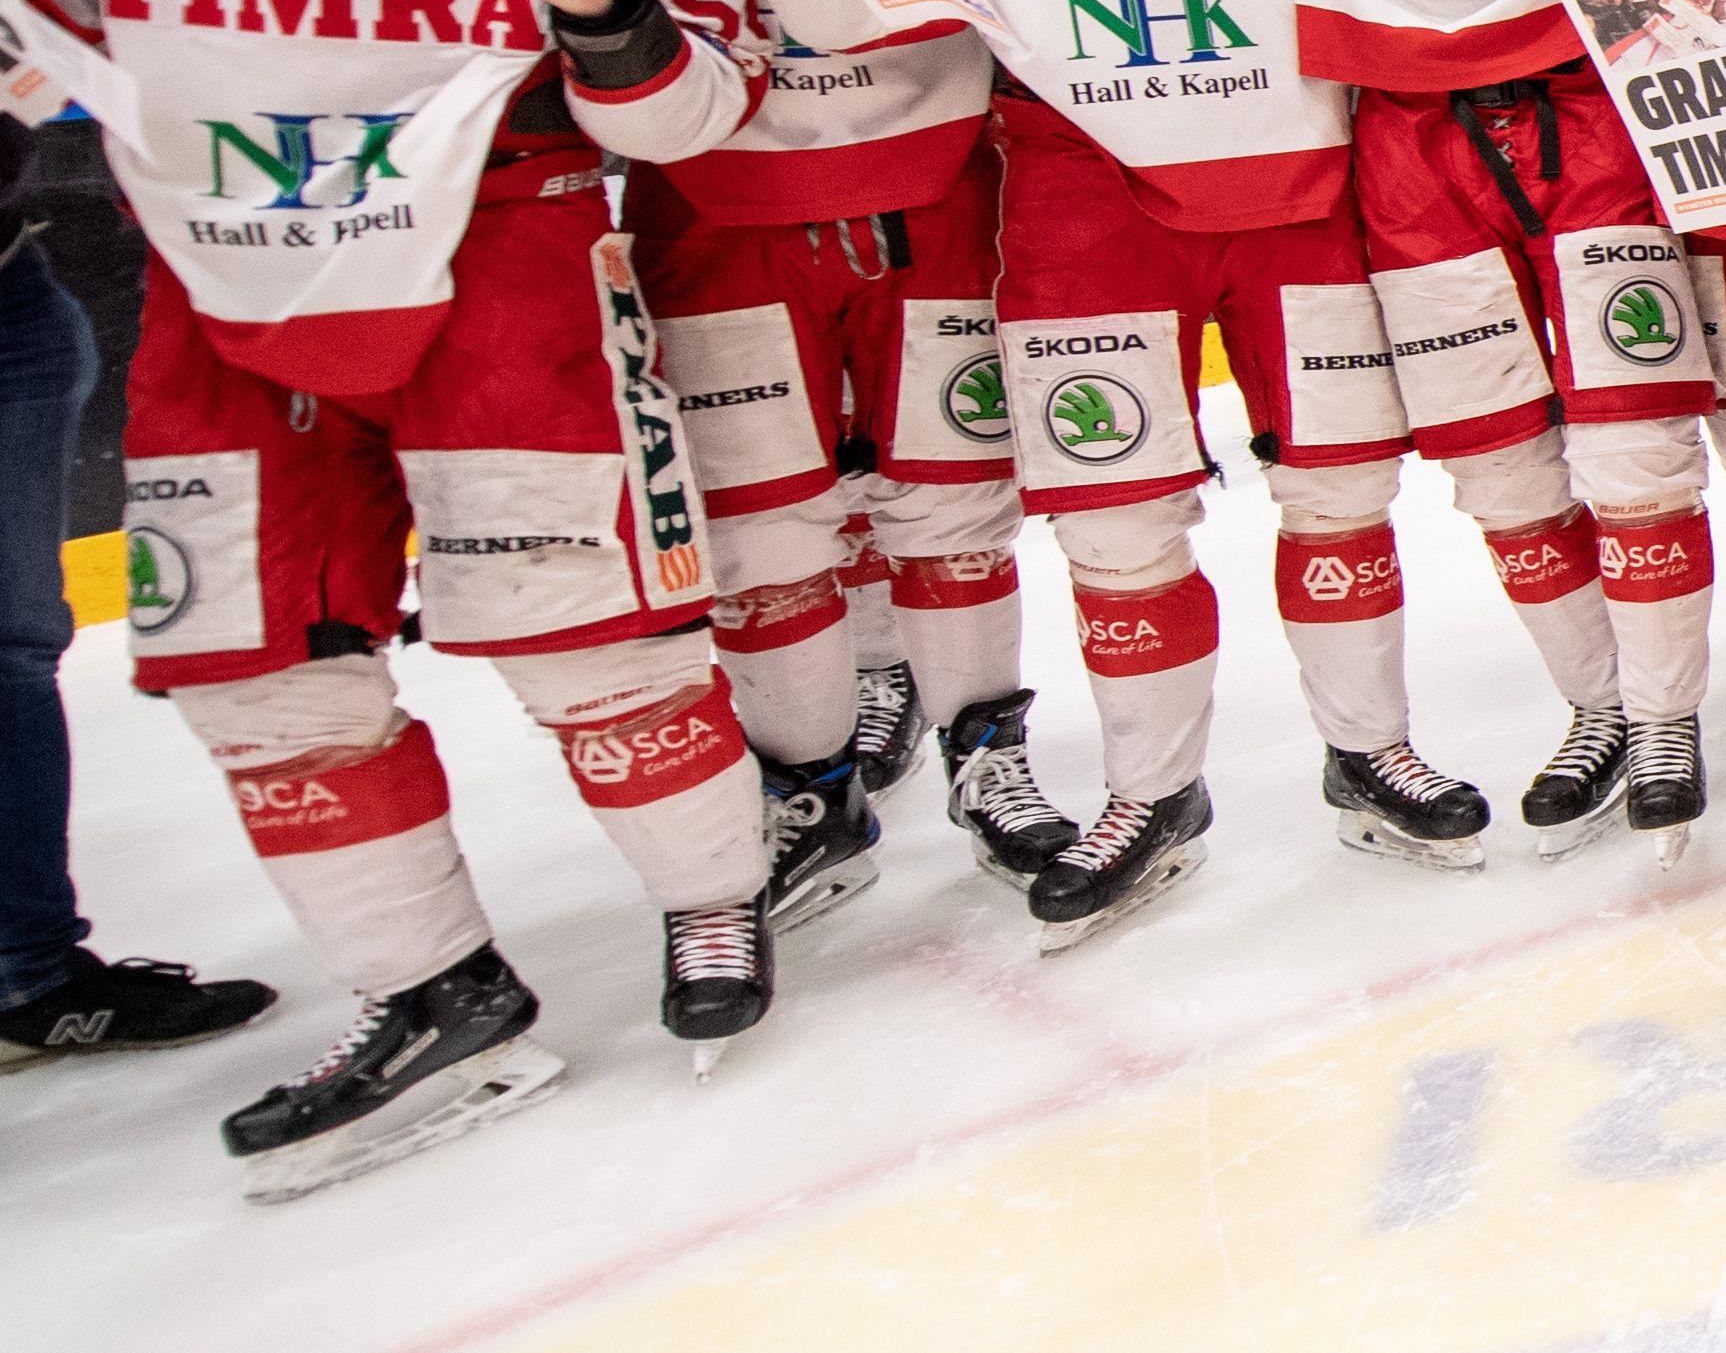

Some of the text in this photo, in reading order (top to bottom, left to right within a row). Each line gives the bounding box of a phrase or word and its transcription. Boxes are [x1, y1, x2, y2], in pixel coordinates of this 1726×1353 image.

[769, 65, 874, 95] Kapell
[1069, 69, 1269, 105] Hall & Kapell
[185, 219, 269, 246] Hall
[282, 219, 316, 247] &
[1583, 242, 1681, 266] ŠKODA
[1025, 334, 1148, 359] ŠKODA
[1507, 545, 1562, 571] SCA
[1628, 542, 1688, 568] SCA
[1091, 619, 1159, 643] SCA
[632, 716, 713, 759] SCA
